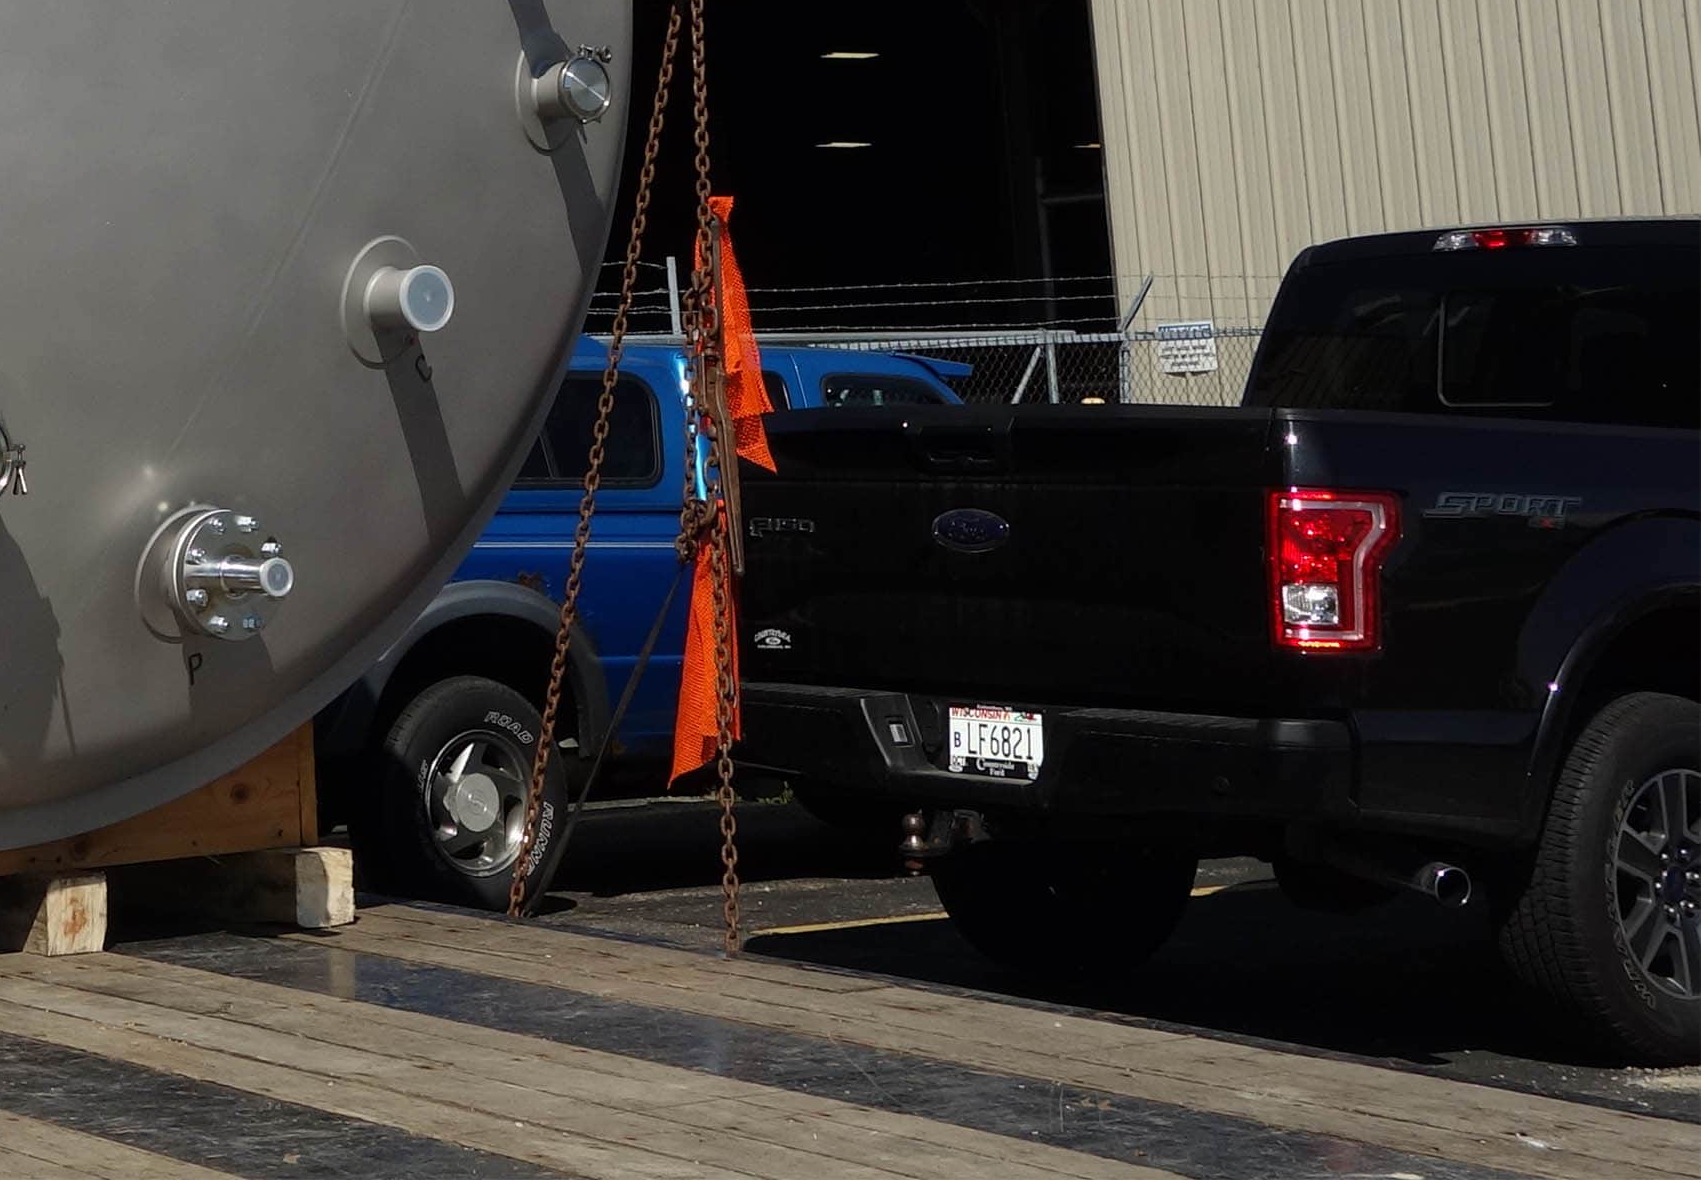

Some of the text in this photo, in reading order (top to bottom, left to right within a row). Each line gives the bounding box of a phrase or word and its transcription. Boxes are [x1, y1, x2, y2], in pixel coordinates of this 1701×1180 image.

[415, 353, 433, 384] C
[1422, 492, 1582, 518] SPORT
[187, 652, 203, 686] P
[485, 711, 534, 744] ROAD
[953, 722, 1033, 760] B LF6821
